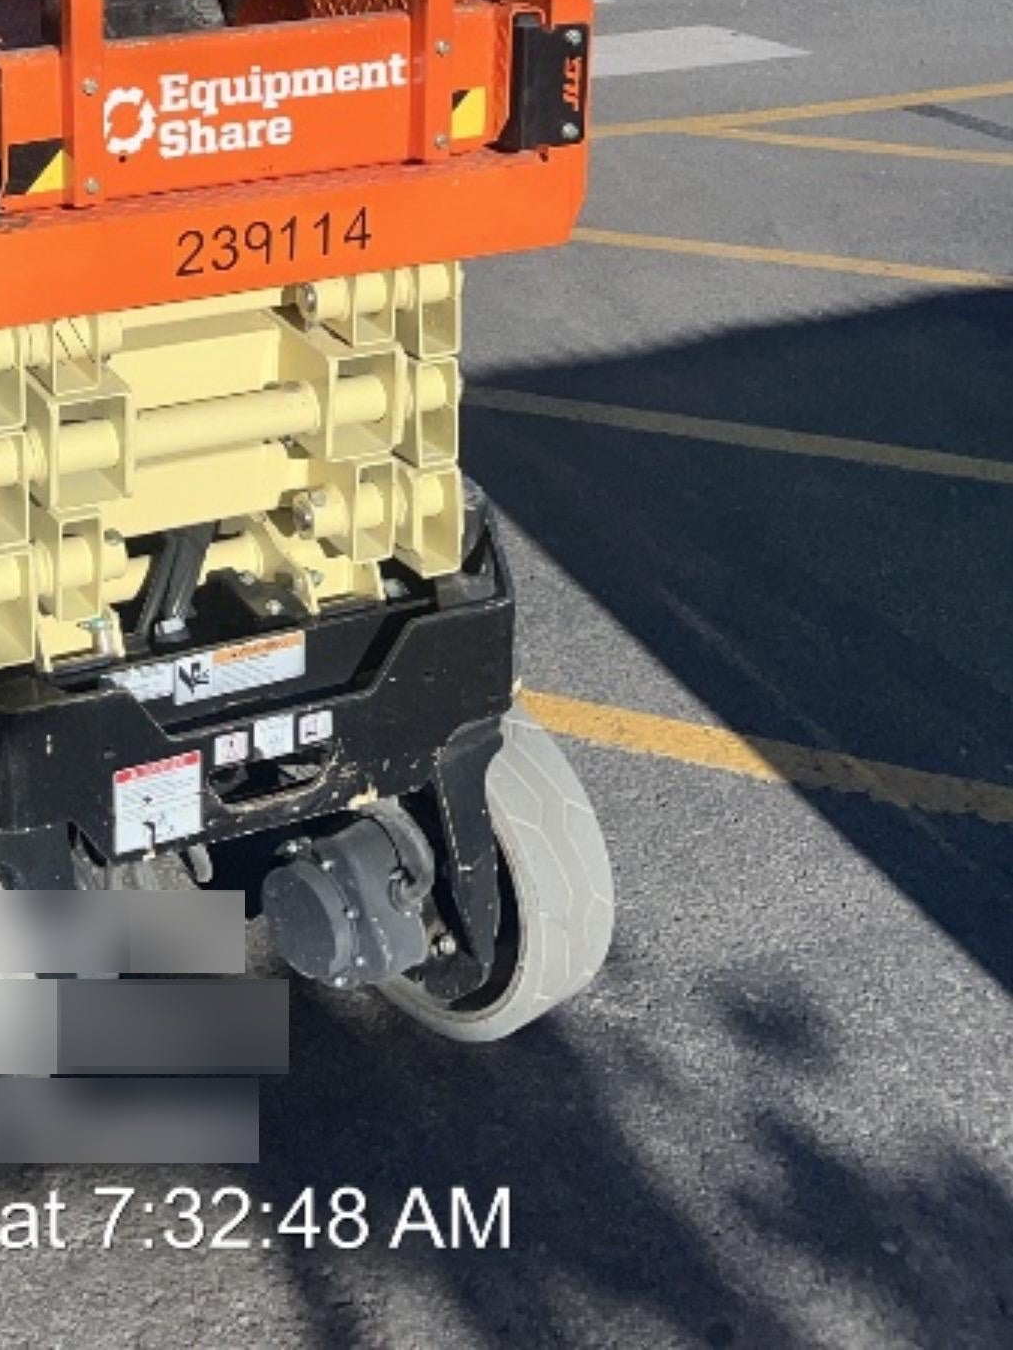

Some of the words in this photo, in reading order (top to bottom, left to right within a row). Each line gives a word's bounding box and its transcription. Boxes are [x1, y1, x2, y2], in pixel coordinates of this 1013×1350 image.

[158, 53, 407, 116] Equipment
[158, 116, 292, 159] Share
[176, 206, 372, 277] 239114
